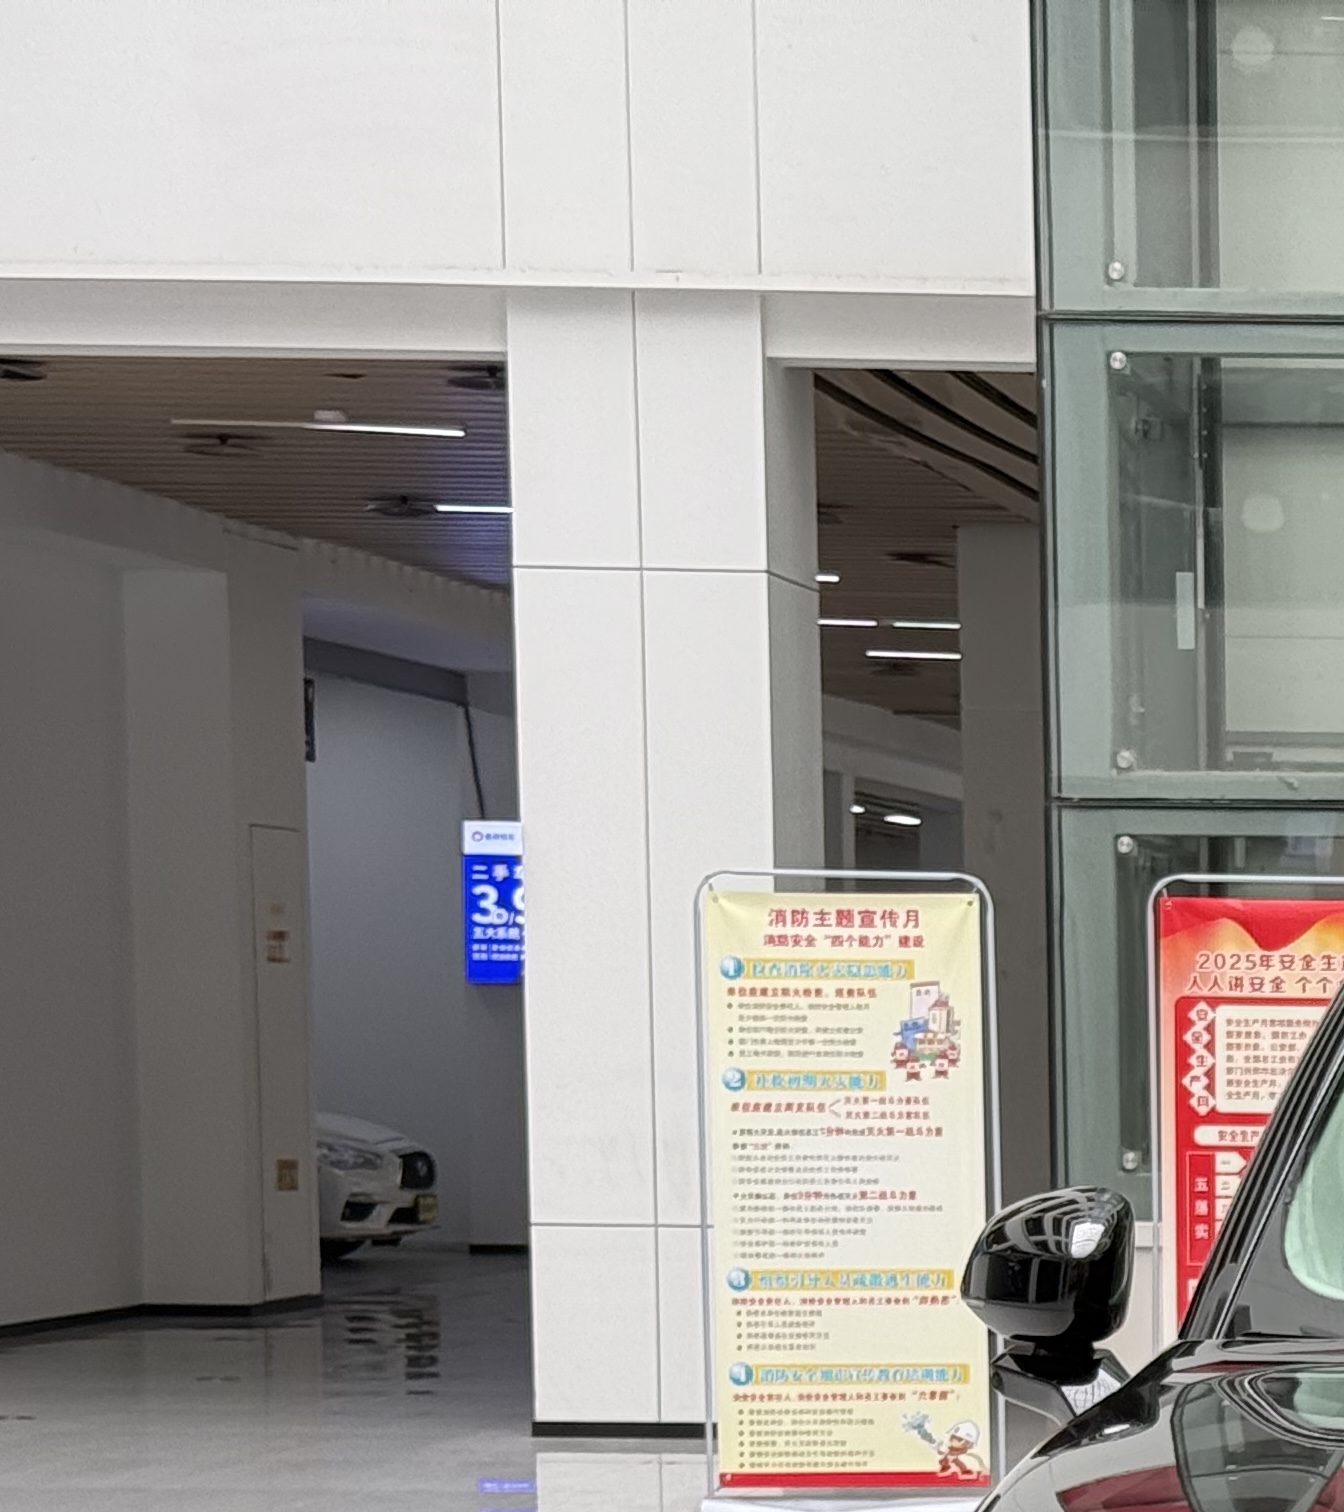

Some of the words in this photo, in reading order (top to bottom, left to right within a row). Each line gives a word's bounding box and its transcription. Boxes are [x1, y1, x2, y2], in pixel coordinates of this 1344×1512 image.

[768, 908, 921, 929] 消防主题宣传月
[1187, 976, 1287, 994] 人人讲安全
[1295, 977, 1344, 994] 个个
